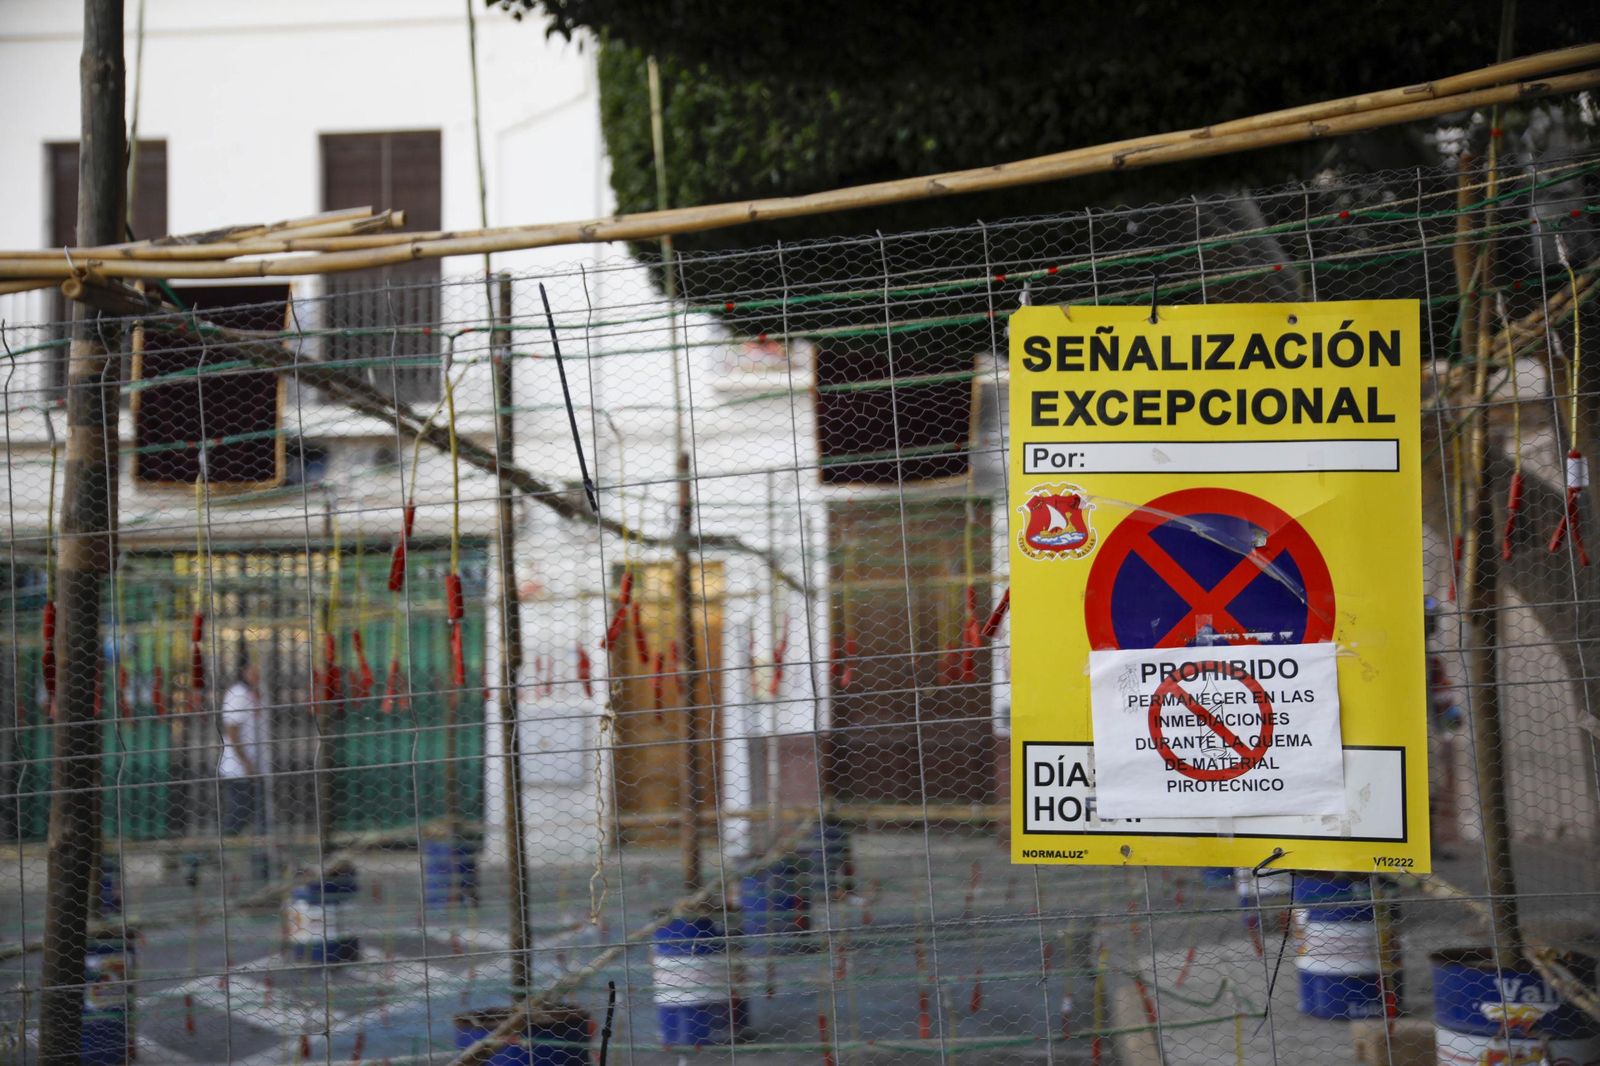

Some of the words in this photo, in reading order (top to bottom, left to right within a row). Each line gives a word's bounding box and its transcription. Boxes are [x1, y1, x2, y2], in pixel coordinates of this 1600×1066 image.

[1022, 320, 1401, 372] SEÑALIZACIÓN
[1031, 387, 1396, 427] EXCEPCIONAL
[1032, 448, 1086, 469] Por:
[1141, 658, 1299, 684] PROHIBIDO
[1128, 691, 1247, 708] PERMANECER
[1252, 691, 1275, 704] EN
[1281, 690, 1315, 704] LAS
[1154, 712, 1290, 729] INMEDIACIONES
[1135, 736, 1216, 750] DURANTE
[1222, 735, 1244, 748] LA
[1249, 734, 1313, 748] QUEMA
[1164, 758, 1187, 771] DE
[1193, 757, 1280, 771] MATERIAL
[1373, 856, 1414, 867] V12222
